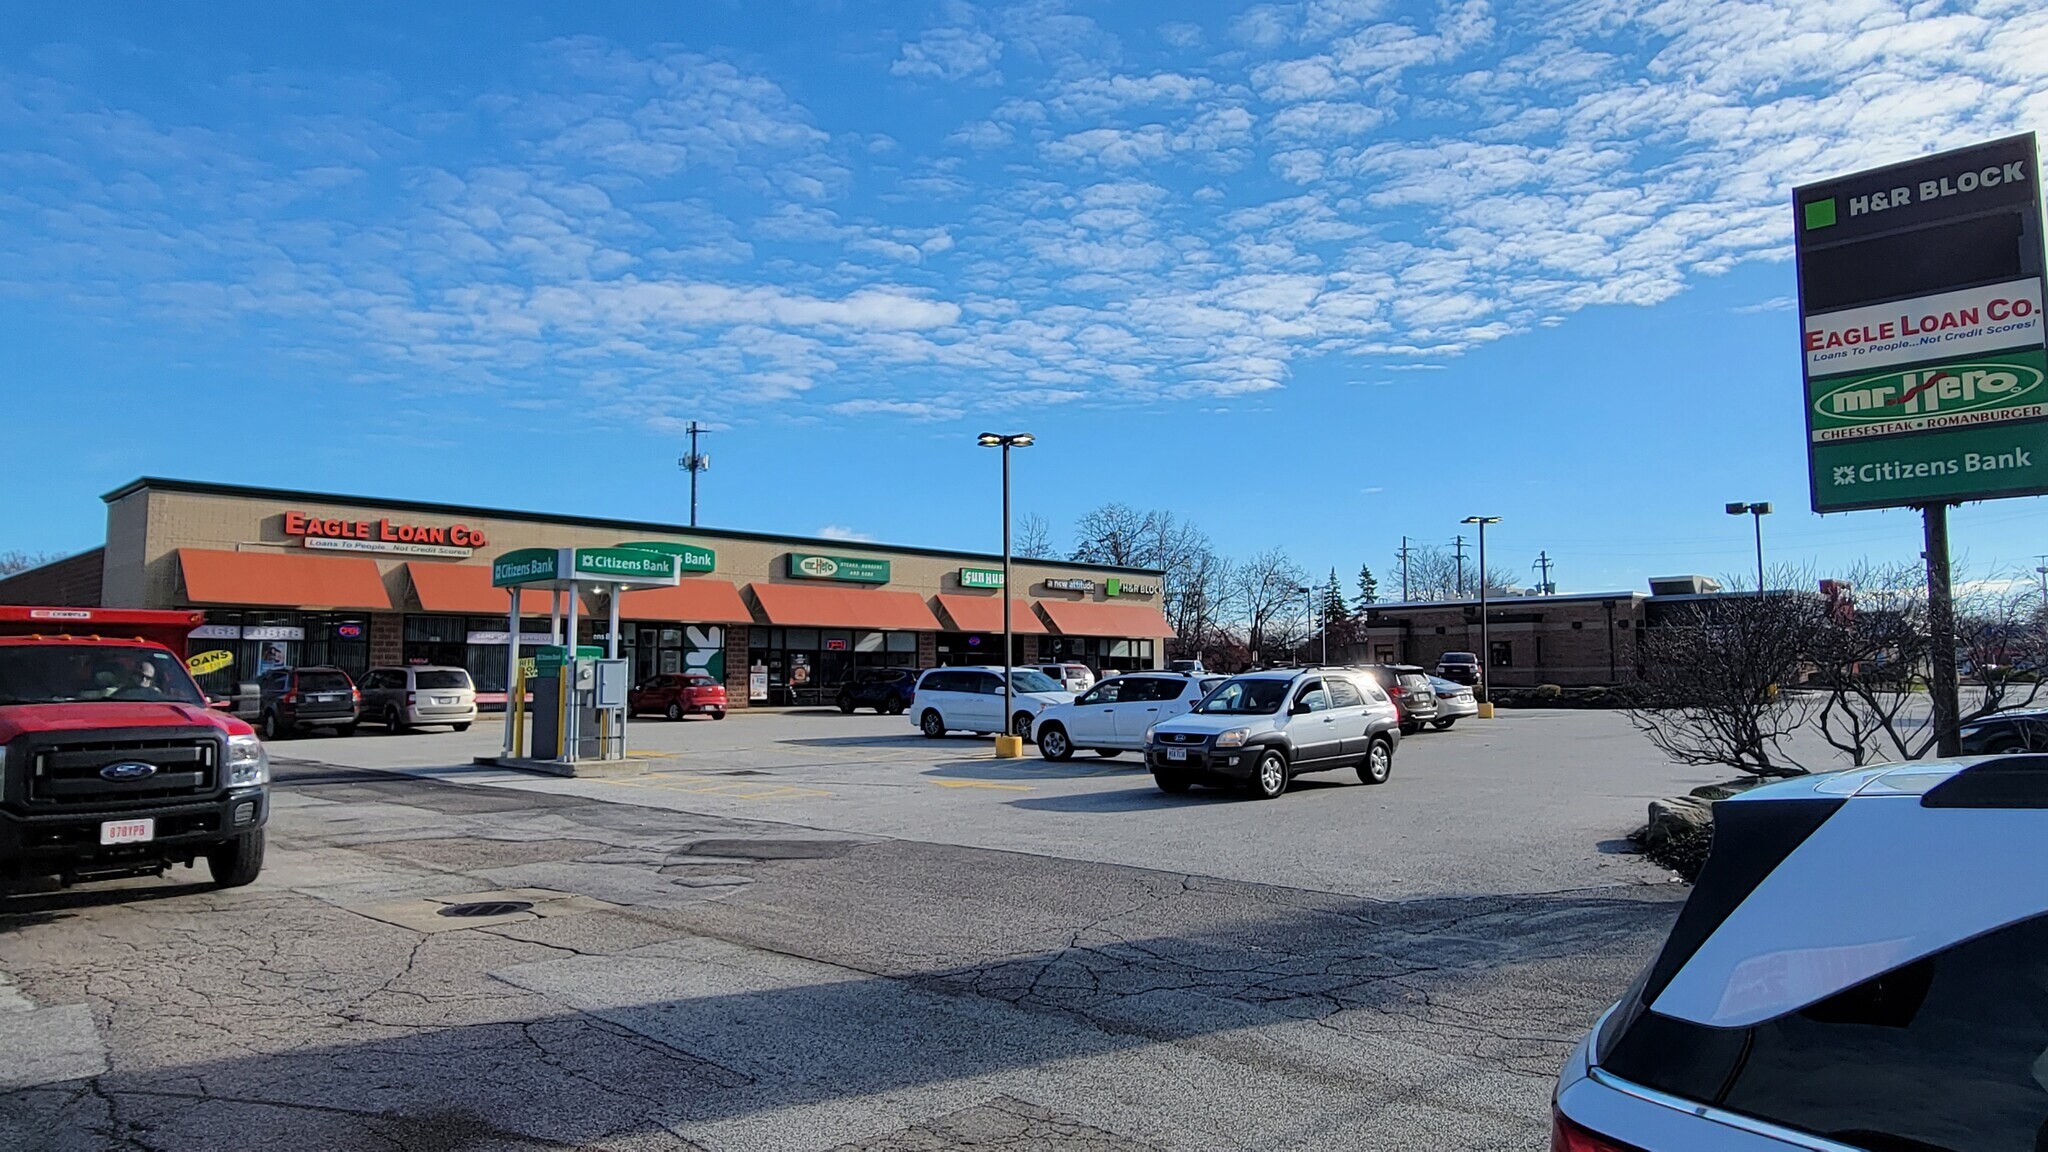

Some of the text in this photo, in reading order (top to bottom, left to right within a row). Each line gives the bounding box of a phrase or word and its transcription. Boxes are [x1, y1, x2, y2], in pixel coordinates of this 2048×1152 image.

[1849, 160, 2026, 216] H&R BLOCK
[1806, 322, 1895, 352] EAGLE
[1901, 307, 1979, 336] LOAN
[1813, 350, 1848, 362] Loans
[1852, 347, 1866, 356] To
[1945, 328, 1982, 341] Credit
[1987, 319, 2036, 335] Scores!
[1821, 406, 2042, 440] CHEESESTEAK ROMANBURGER
[1859, 447, 2032, 483] Citizens Bank
[285, 511, 370, 538] EAGLE
[380, 518, 445, 544] LOAN
[309, 539, 338, 547] Loans
[410, 545, 436, 553] Credit
[685, 552, 711, 566] Bank
[501, 556, 554, 578] Citizens Bank
[595, 556, 669, 572] Citizens Bank
[1122, 585, 1138, 593] H&R
[191, 651, 228, 667] OANS
